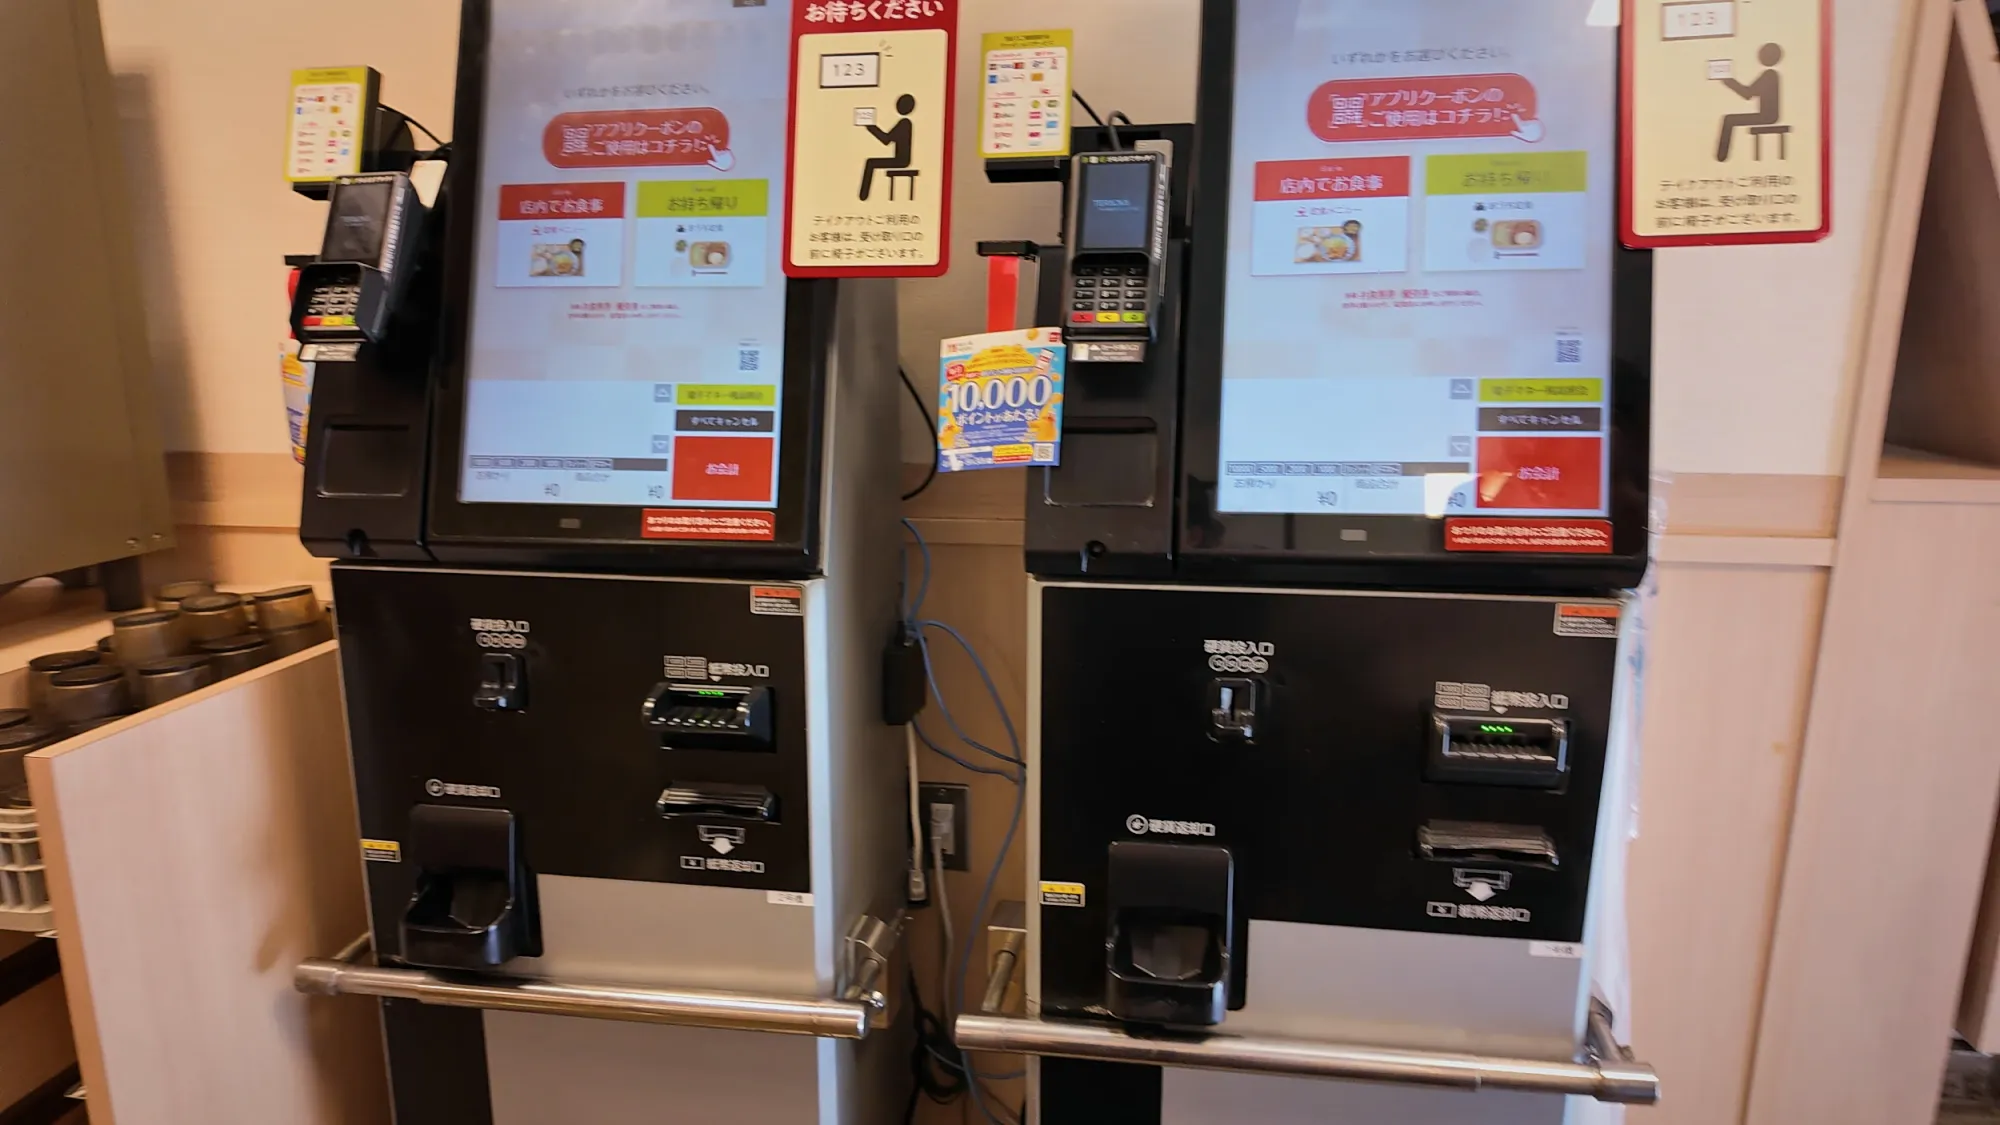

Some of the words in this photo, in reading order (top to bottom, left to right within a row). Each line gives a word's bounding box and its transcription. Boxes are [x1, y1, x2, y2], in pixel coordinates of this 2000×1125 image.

[804, 0, 945, 24] お待ちください
[833, 63, 865, 77] 123
[1370, 88, 1504, 107] アプリクーポンの
[592, 120, 703, 138] アプリクーポンの
[1280, 175, 1383, 195] 店内でお食事
[520, 198, 605, 214] 店内でお食事
[668, 196, 739, 212] お持ち帰り
[947, 374, 1053, 414] 10,000
